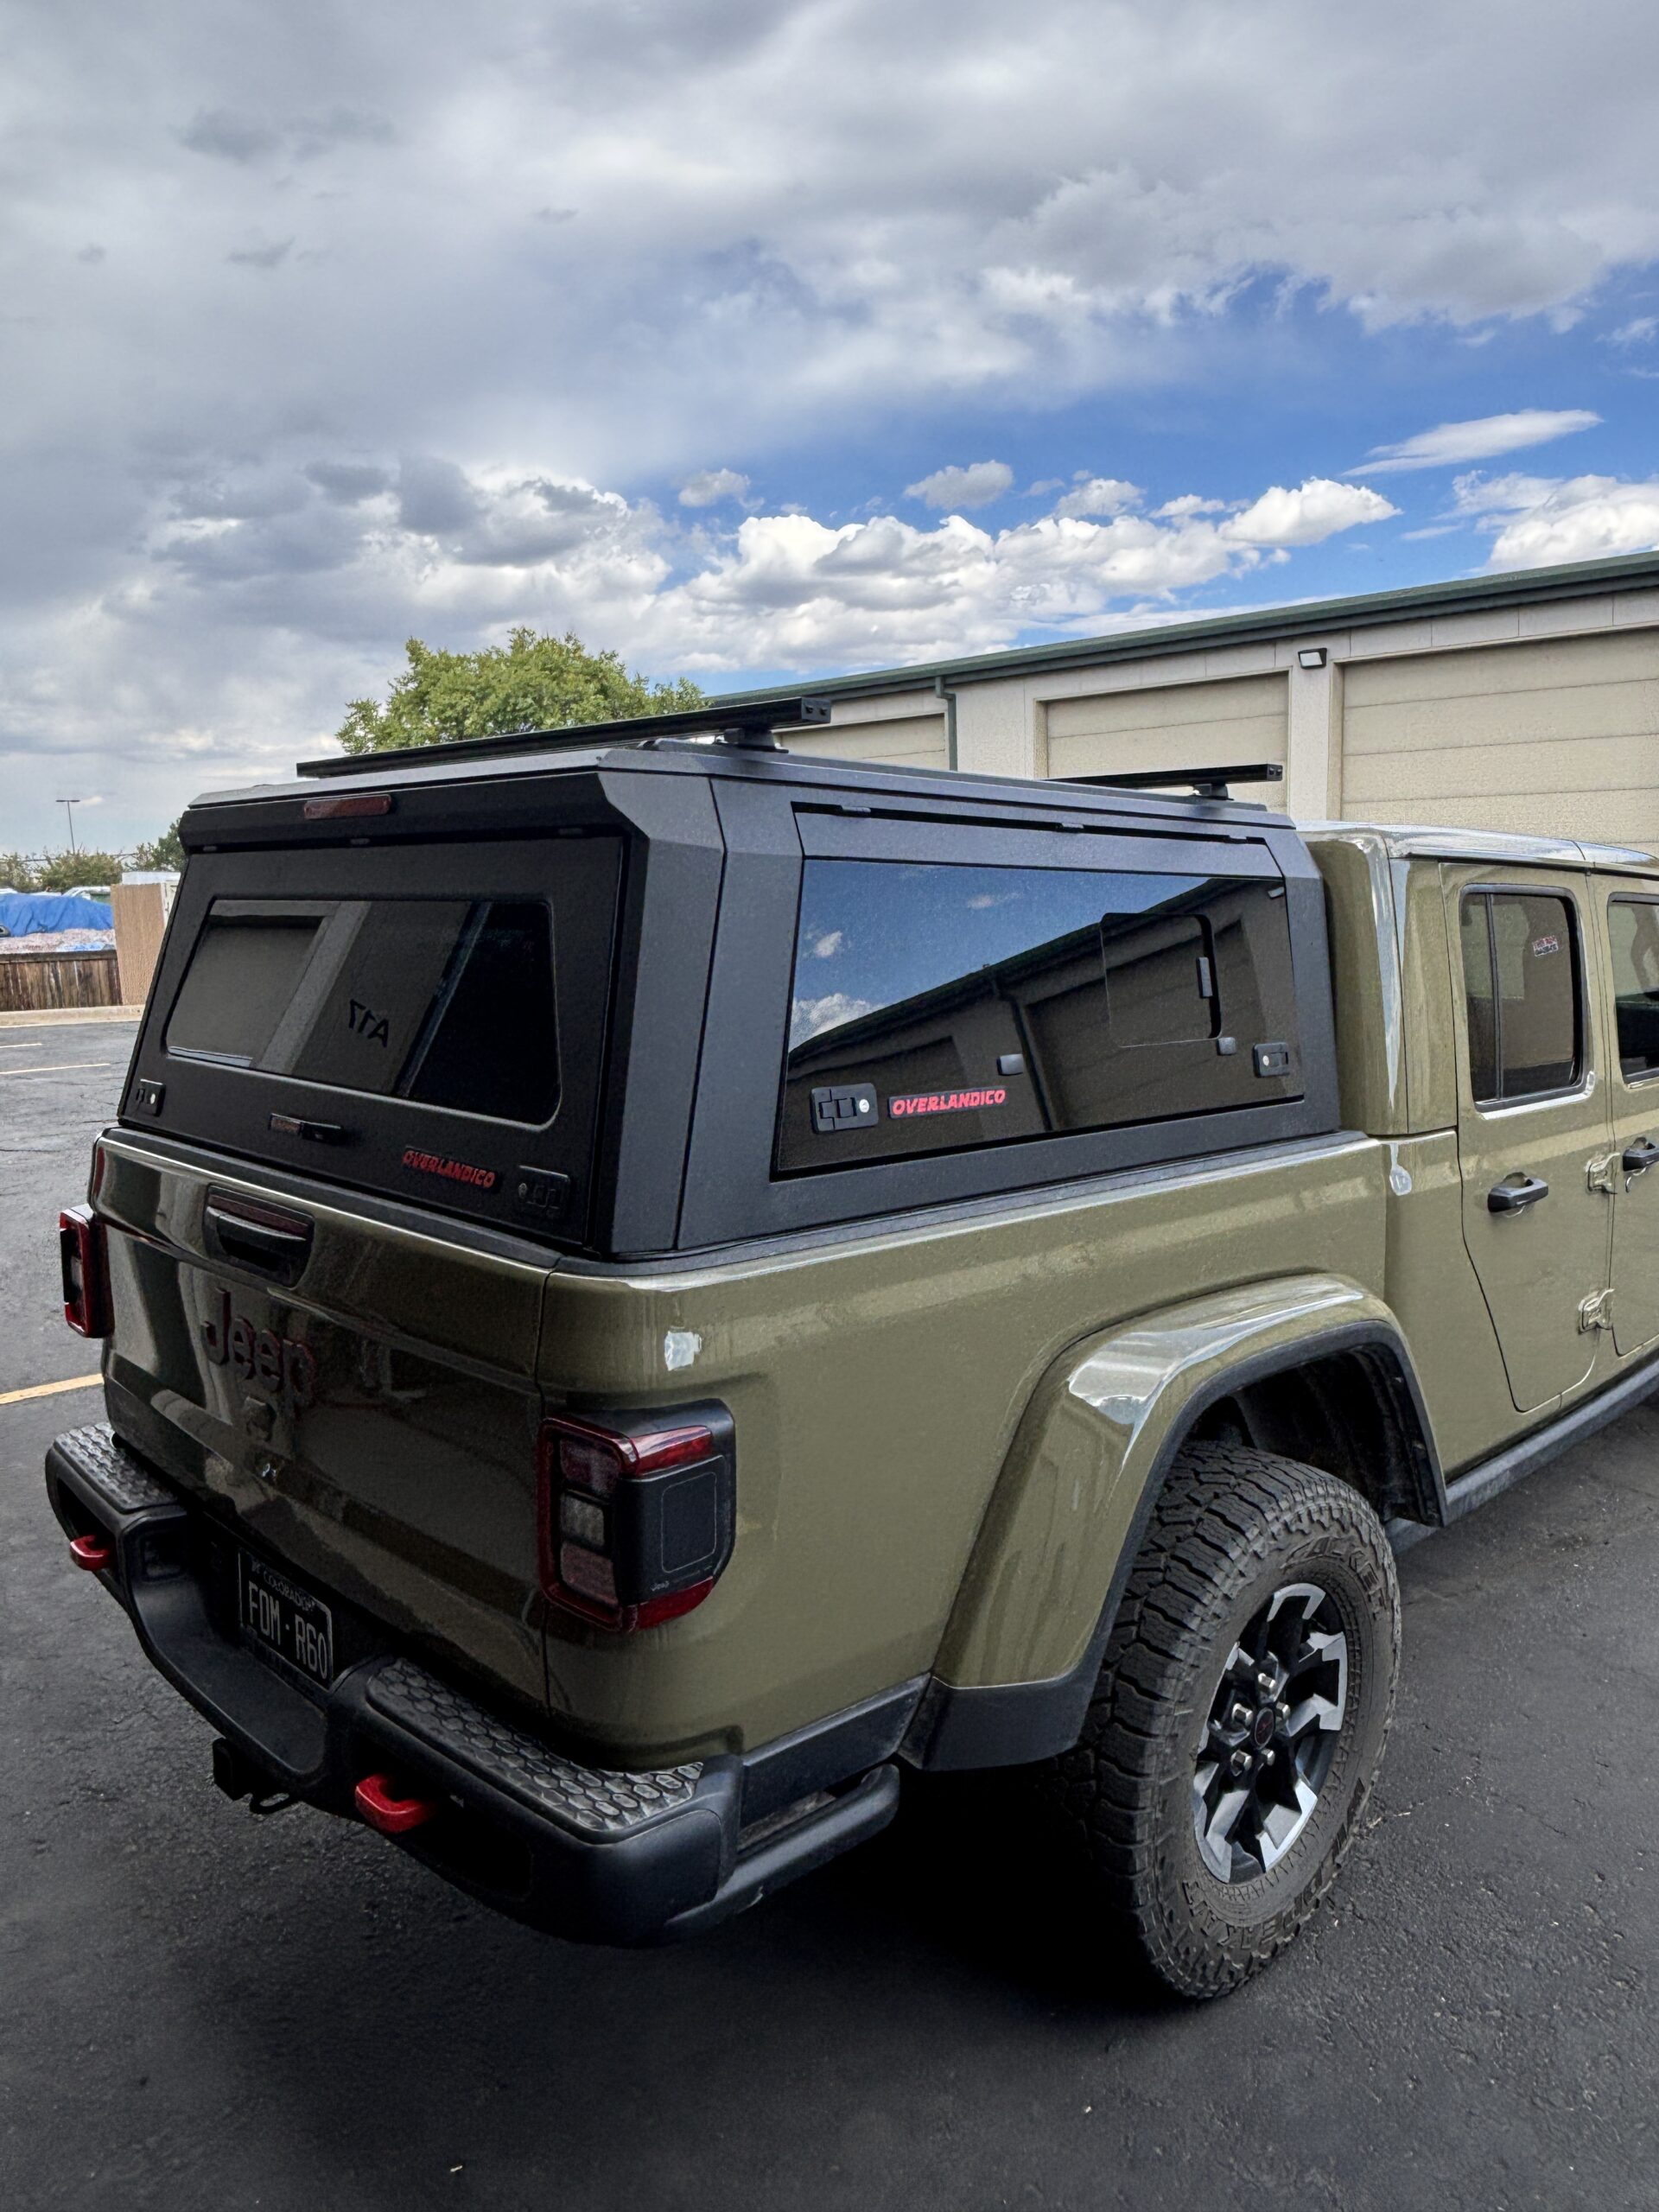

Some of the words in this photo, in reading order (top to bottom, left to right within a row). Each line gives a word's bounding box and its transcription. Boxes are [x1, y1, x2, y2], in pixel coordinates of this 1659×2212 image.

[892, 1089, 1007, 1116] OVERLANDICO
[402, 1149, 496, 1189] OVERLANDICO
[200, 1287, 317, 1421] Jeep
